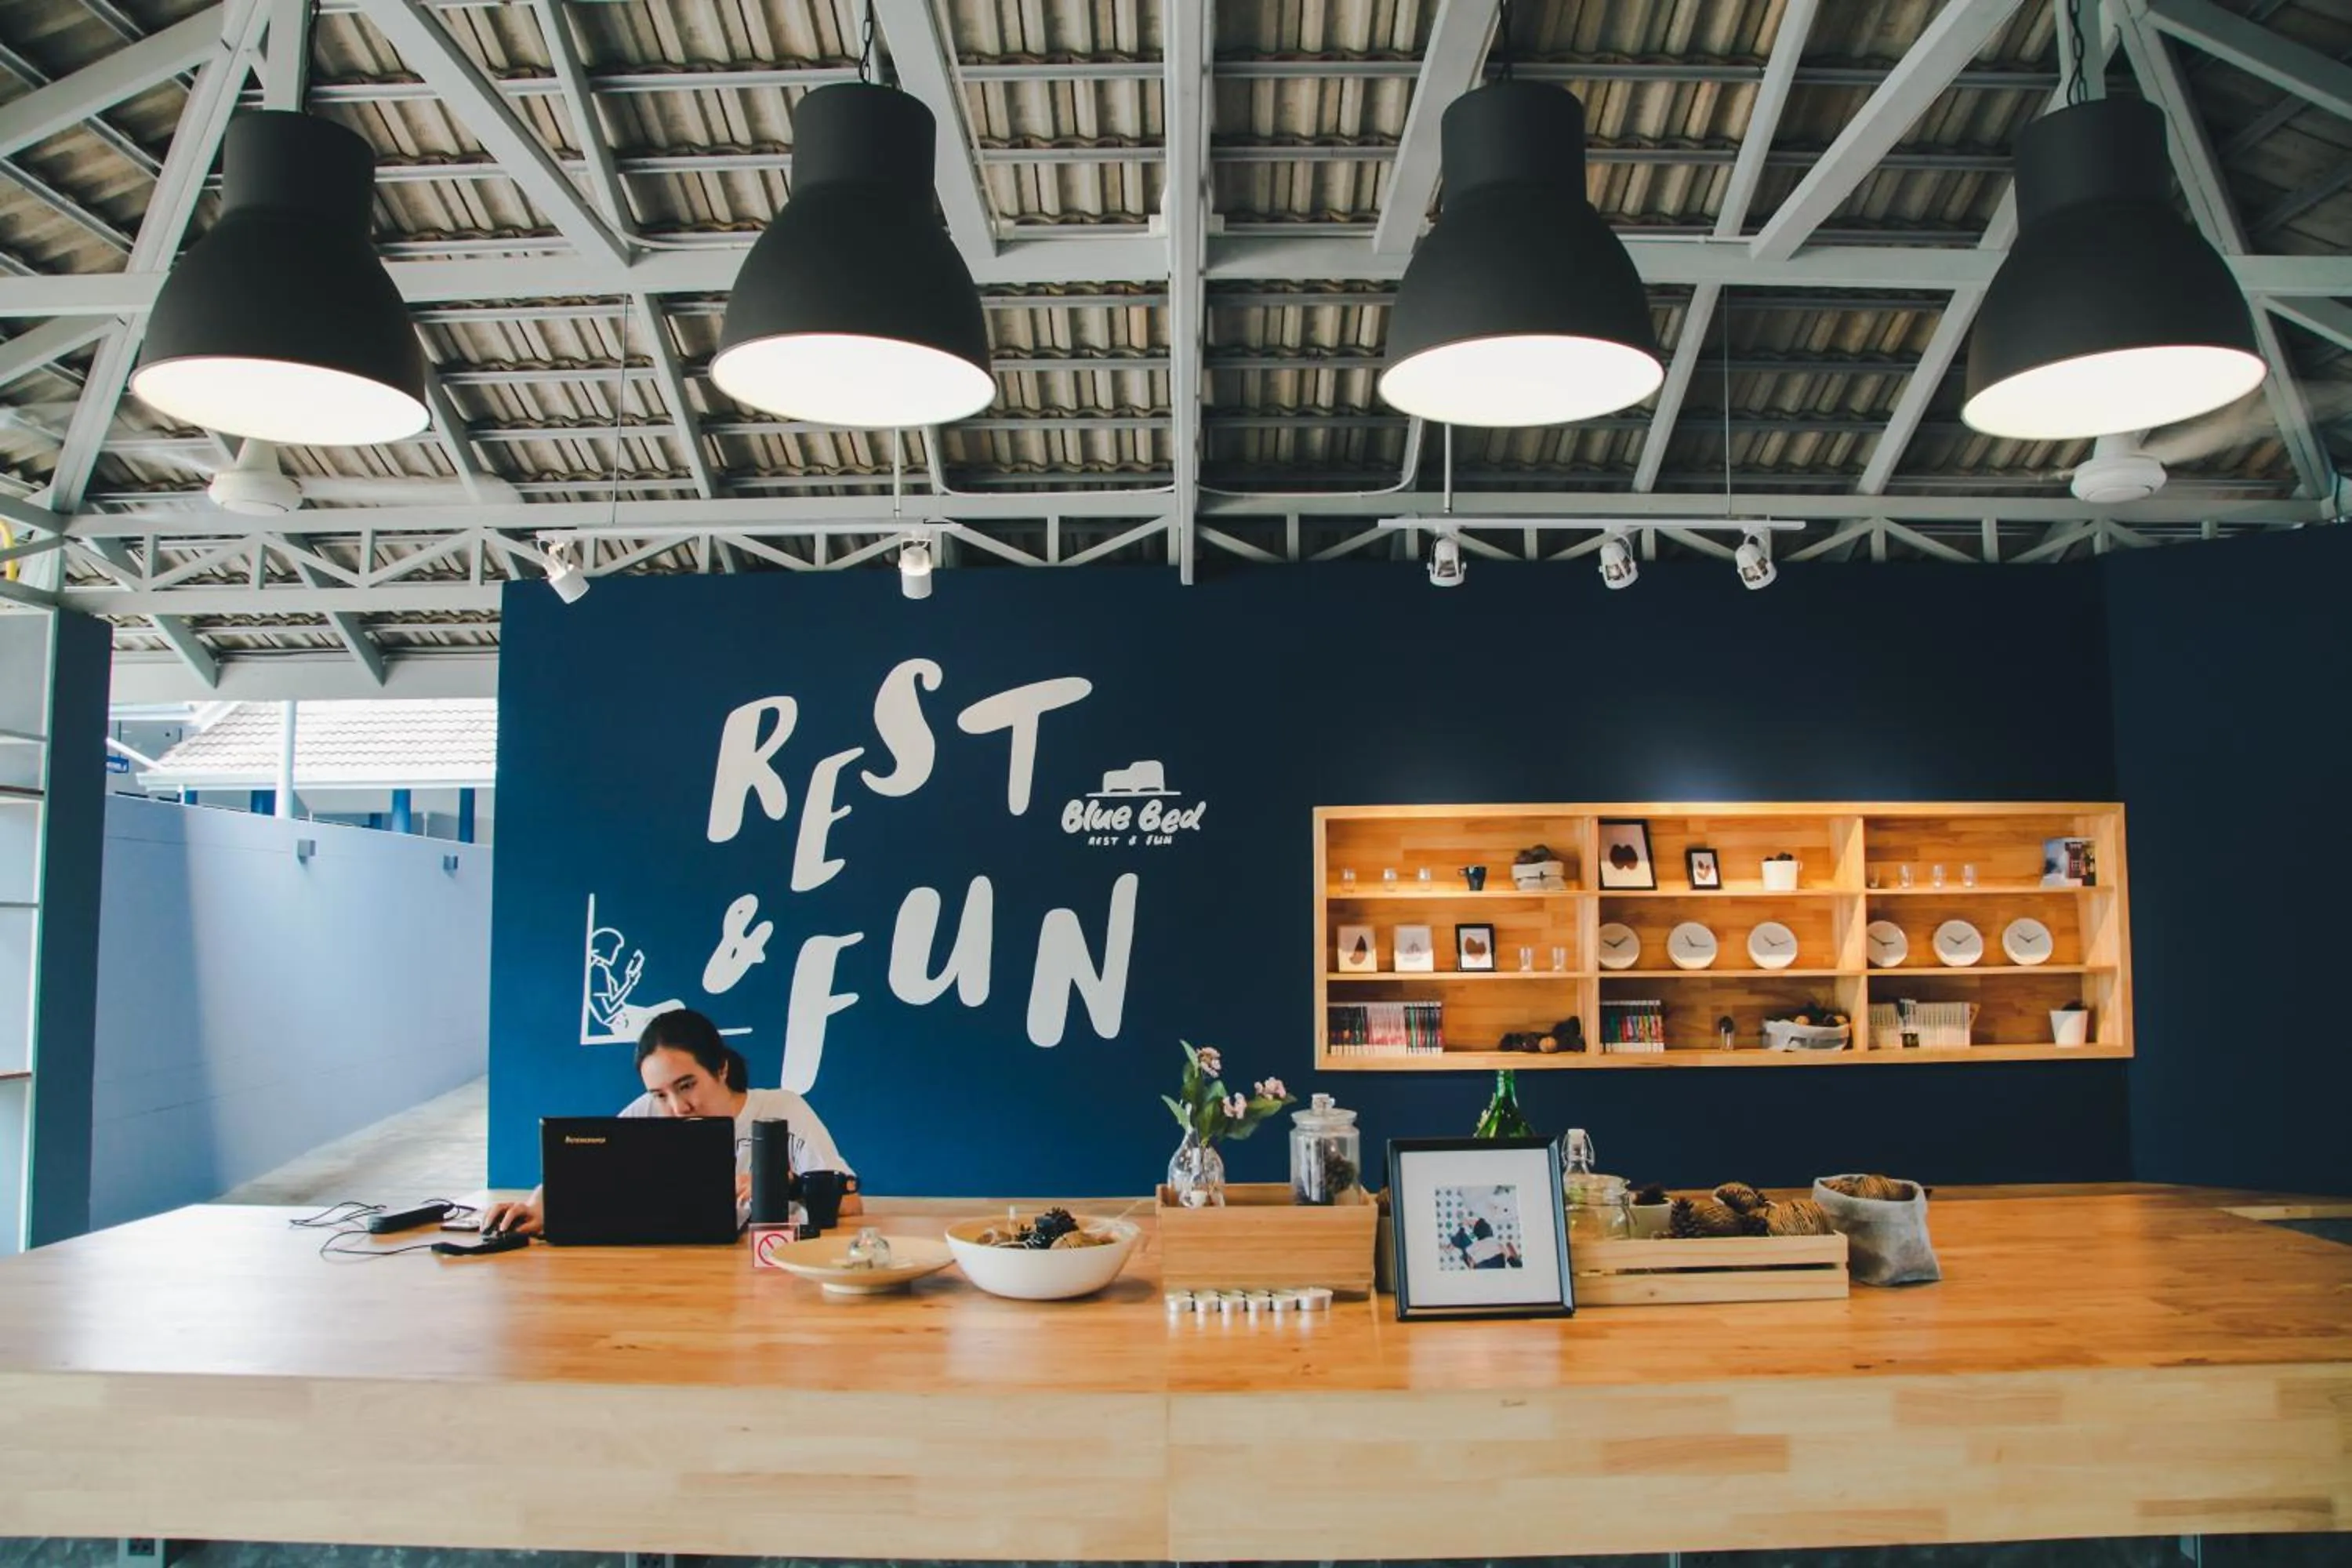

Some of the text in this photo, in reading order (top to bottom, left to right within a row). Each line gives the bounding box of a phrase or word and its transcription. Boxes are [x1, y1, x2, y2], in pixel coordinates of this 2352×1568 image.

[707, 659, 1093, 891] REST
[1062, 799, 1207, 834] Blue Bed
[1087, 836, 1119, 846] REST
[702, 873, 1138, 1095] & FUN
